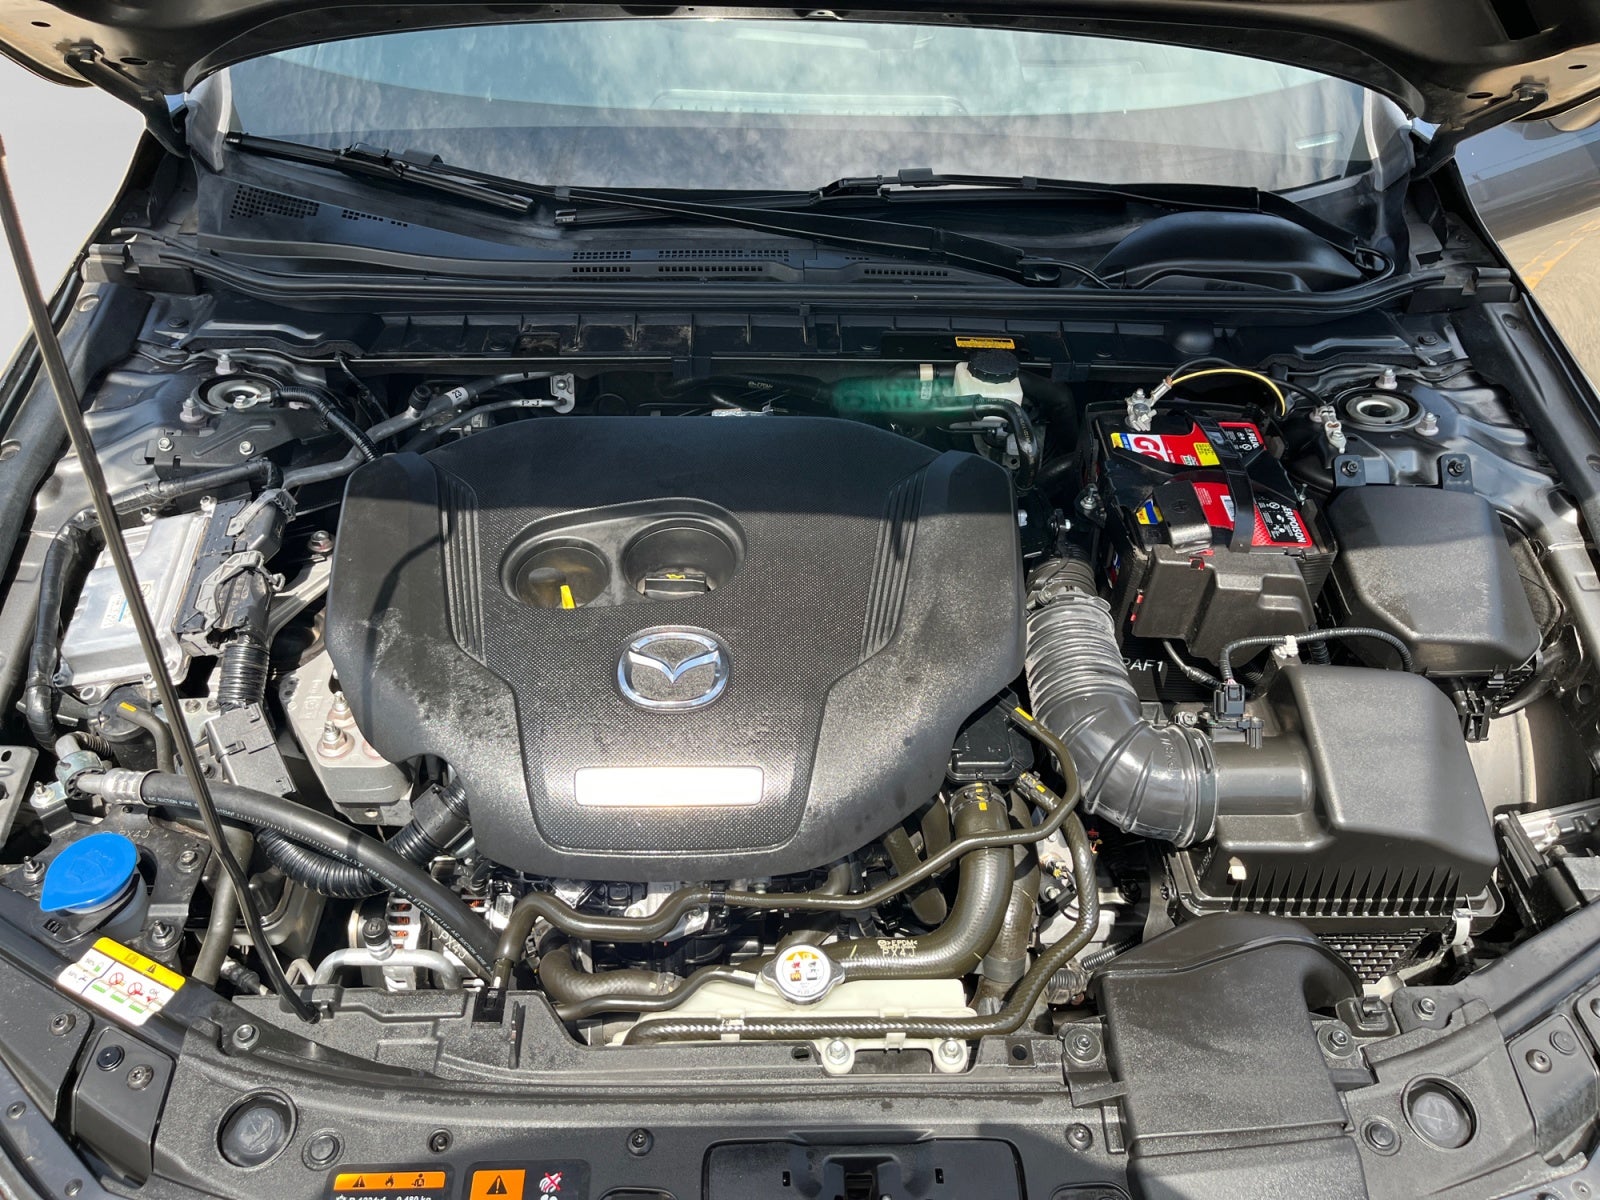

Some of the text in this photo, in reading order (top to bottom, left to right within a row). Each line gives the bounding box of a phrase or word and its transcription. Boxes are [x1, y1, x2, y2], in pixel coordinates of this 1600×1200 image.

[451, 389, 463, 399] 23
[1281, 504, 1306, 543] ER/POISON
[332, 849, 364, 868] GALAXY
